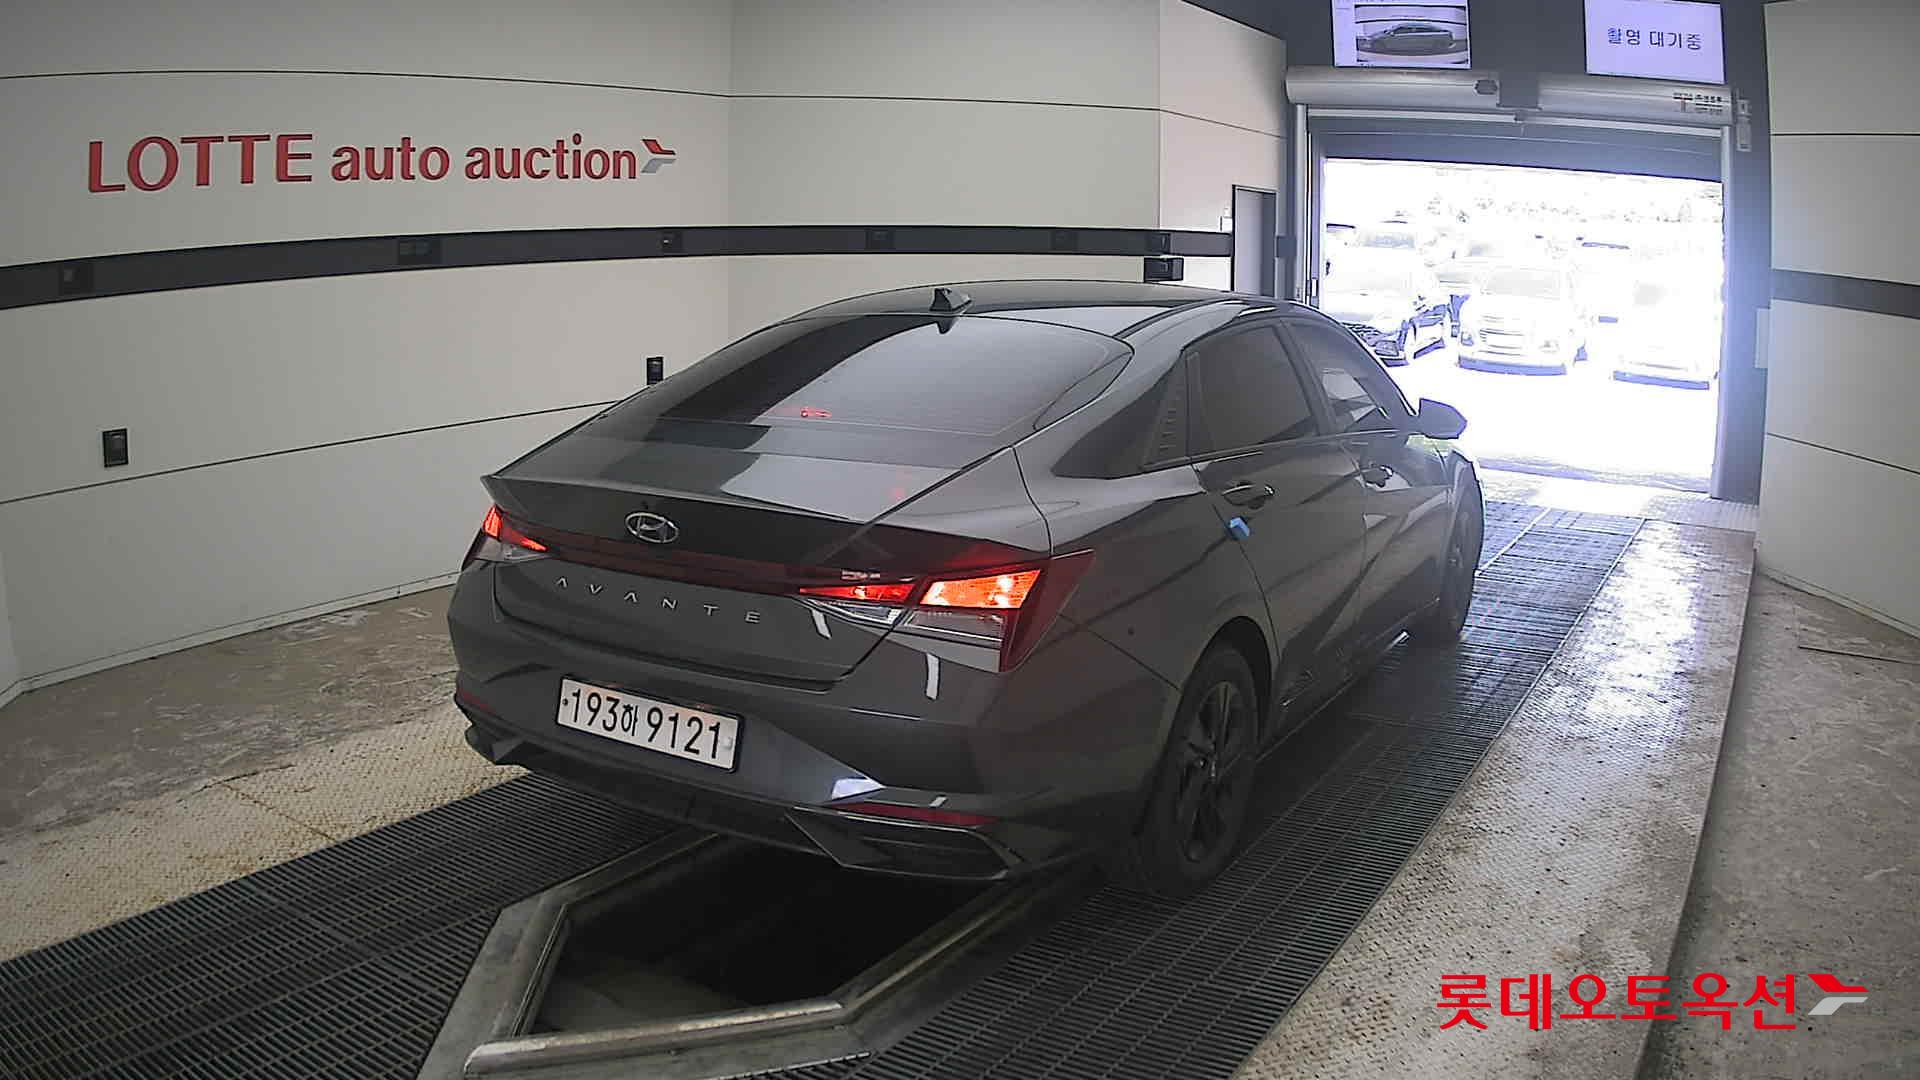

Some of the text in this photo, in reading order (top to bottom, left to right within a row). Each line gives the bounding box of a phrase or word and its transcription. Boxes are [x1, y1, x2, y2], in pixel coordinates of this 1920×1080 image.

[1649, 31, 1702, 50] 대기중
[88, 132, 637, 193] LOTTE auto auction
[555, 576, 761, 624] AVANTE
[646, 707, 721, 760] 9121
